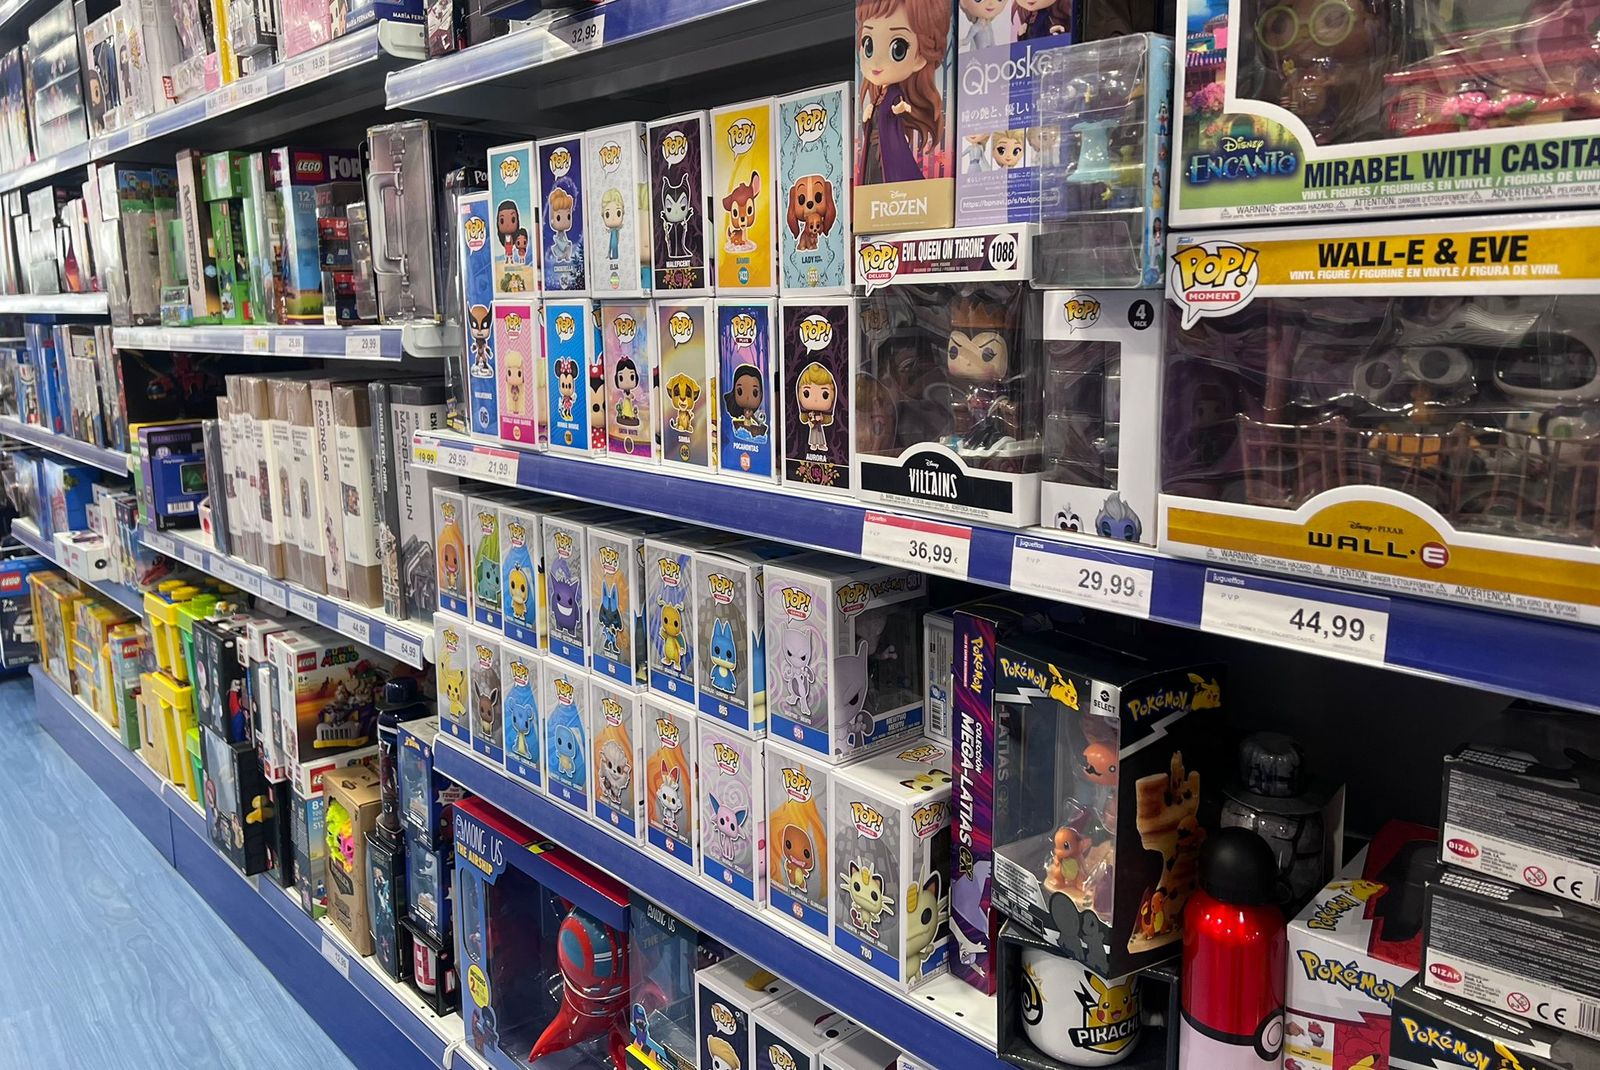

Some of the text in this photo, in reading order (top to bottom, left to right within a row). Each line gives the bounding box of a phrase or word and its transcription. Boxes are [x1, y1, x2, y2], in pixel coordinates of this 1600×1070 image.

[571, 24, 597, 44] 32,99
[1222, 136, 1264, 154] Disney
[297, 160, 321, 172] LEGO
[1188, 151, 1298, 183] ENCANTO
[1304, 138, 1600, 188] MIRABEL WITH CASITA
[1301, 190, 1329, 200] VINYL
[1331, 186, 1371, 199] FIGURES
[1381, 182, 1434, 195] FIGURINES
[1438, 180, 1451, 190] EN
[1455, 177, 1493, 189] VINYLE
[1504, 172, 1553, 185] FIGURAS
[1557, 171, 1573, 182] DE
[870, 198, 928, 219] FROZEN
[801, 256, 815, 264] LADY
[859, 243, 898, 273] POP!
[902, 237, 985, 262] EVIL QUEEN ON THRONE
[991, 241, 1015, 263] 1088
[1318, 235, 1529, 268] WALL-E & EVE
[1171, 246, 1260, 292] POP!
[1290, 263, 1560, 280] VINYL FIGURE FIGURINE EN VINYLE FIGURA DE VINIL
[1189, 292, 1237, 300] MOMENT
[1064, 299, 1101, 320] POP!
[1135, 301, 1147, 319] 4
[480, 411, 488, 423] 06
[317, 399, 329, 482] RACING CAR
[732, 442, 760, 453] POCAHONTAS
[488, 461, 508, 475] 21,99
[805, 453, 828, 463] AURORA
[909, 468, 958, 499] VILLAINS
[404, 483, 414, 520] RUN
[908, 540, 953, 564] 36,99
[1078, 567, 1137, 597] 29,99
[782, 587, 811, 612] POP!
[836, 583, 870, 607] POP!
[352, 622, 366, 635] 44,99
[1289, 608, 1365, 641] 44,99
[1093, 699, 1116, 714] SELECT
[656, 718, 679, 741] POP!
[713, 742, 740, 767] POP!
[974, 721, 985, 774] COLECCIÓN
[781, 767, 812, 795] POP!
[958, 711, 975, 847] MEGA-LATIAS
[850, 801, 884, 827] POP!
[910, 802, 944, 828] POP!
[455, 814, 503, 866] AMONG US
[1448, 841, 1478, 856] BIZAK
[456, 840, 493, 876] THE AIRSHIP
[667, 919, 676, 933] US
[1430, 966, 1461, 981] BIZAK
[711, 1004, 737, 1030] POP!
[1400, 1016, 1491, 1069] Pokémon
